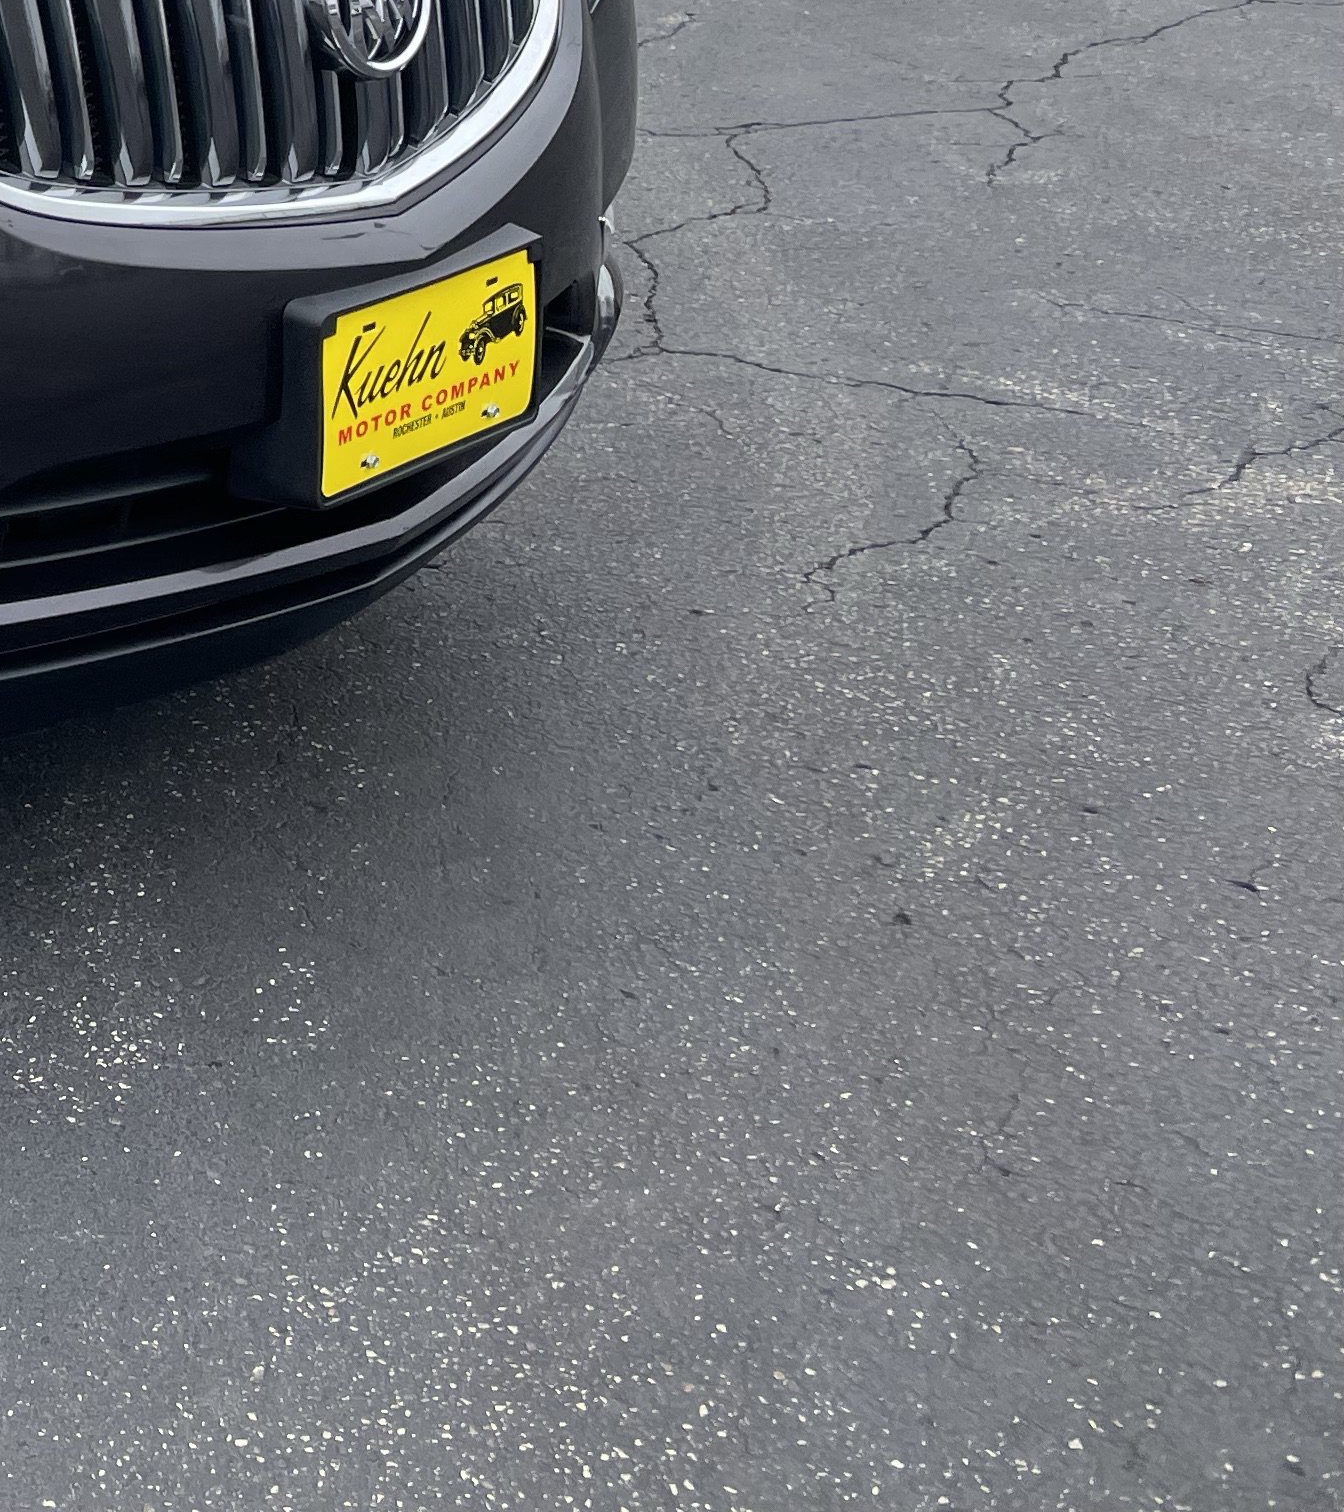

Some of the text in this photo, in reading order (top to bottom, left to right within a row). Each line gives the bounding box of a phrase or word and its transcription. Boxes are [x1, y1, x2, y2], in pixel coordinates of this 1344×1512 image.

[331, 311, 447, 420] Kuehn
[337, 359, 520, 446] MOTOR COMPANY
[392, 399, 466, 439] ROCHESTER AUSTIN
